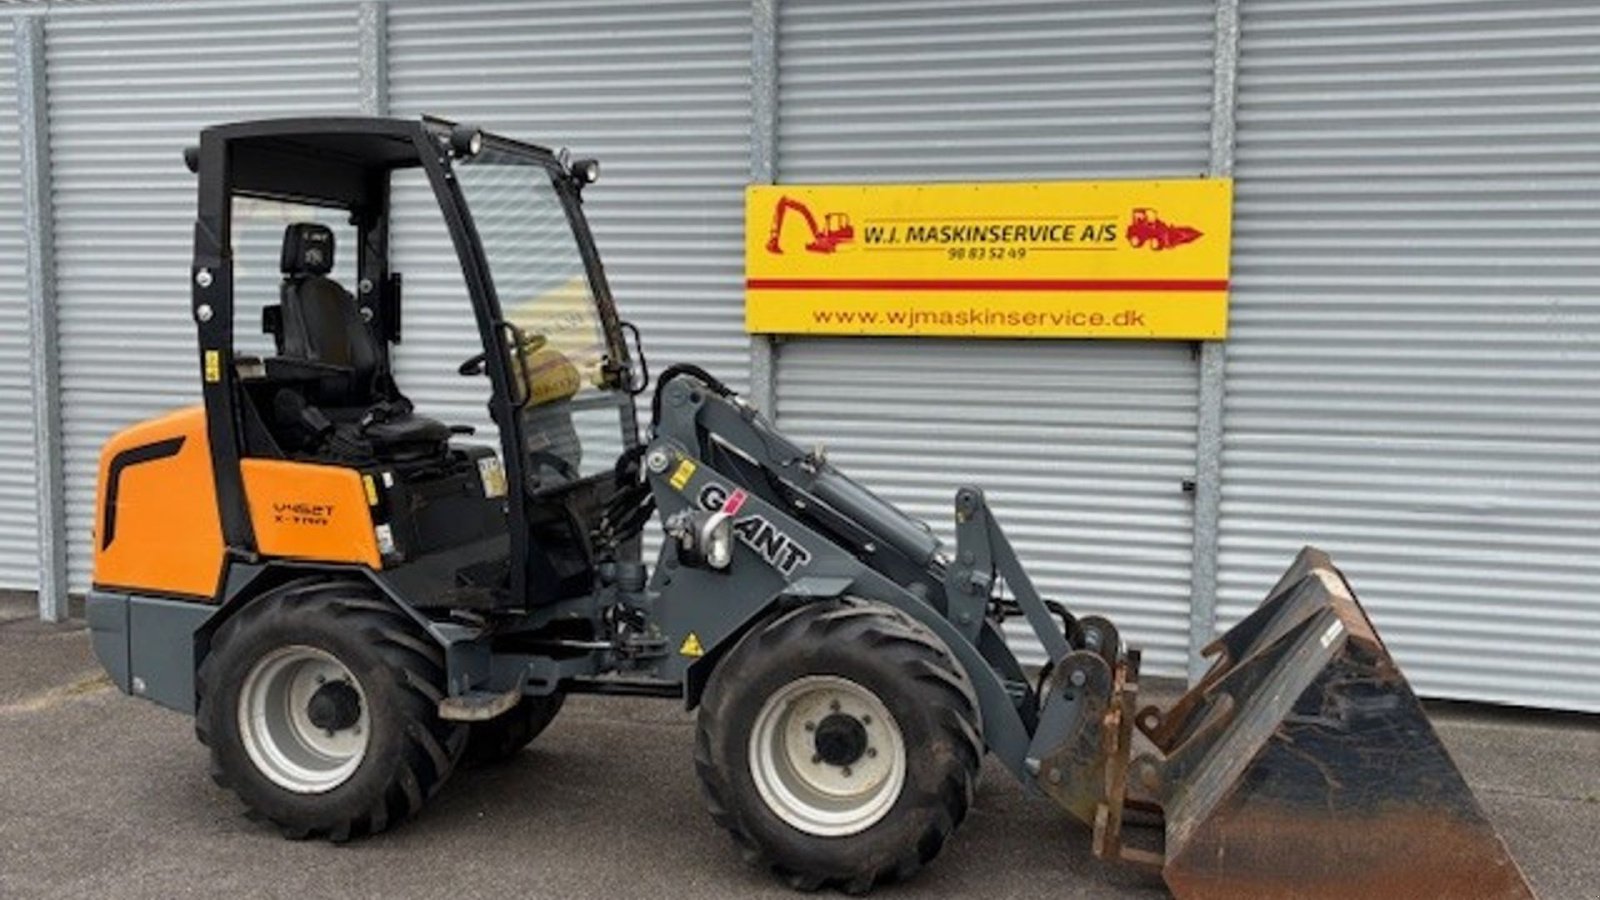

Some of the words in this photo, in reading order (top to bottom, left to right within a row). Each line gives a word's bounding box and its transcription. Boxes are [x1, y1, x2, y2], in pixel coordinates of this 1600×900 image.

[905, 224, 1076, 243] MASKINSERVICE
[1079, 224, 1117, 242] A/S
[948, 246, 966, 260] 98
[989, 246, 1005, 260] 52
[1007, 246, 1026, 260] 49
[812, 307, 1146, 328] www.wjmaskinservice.dk
